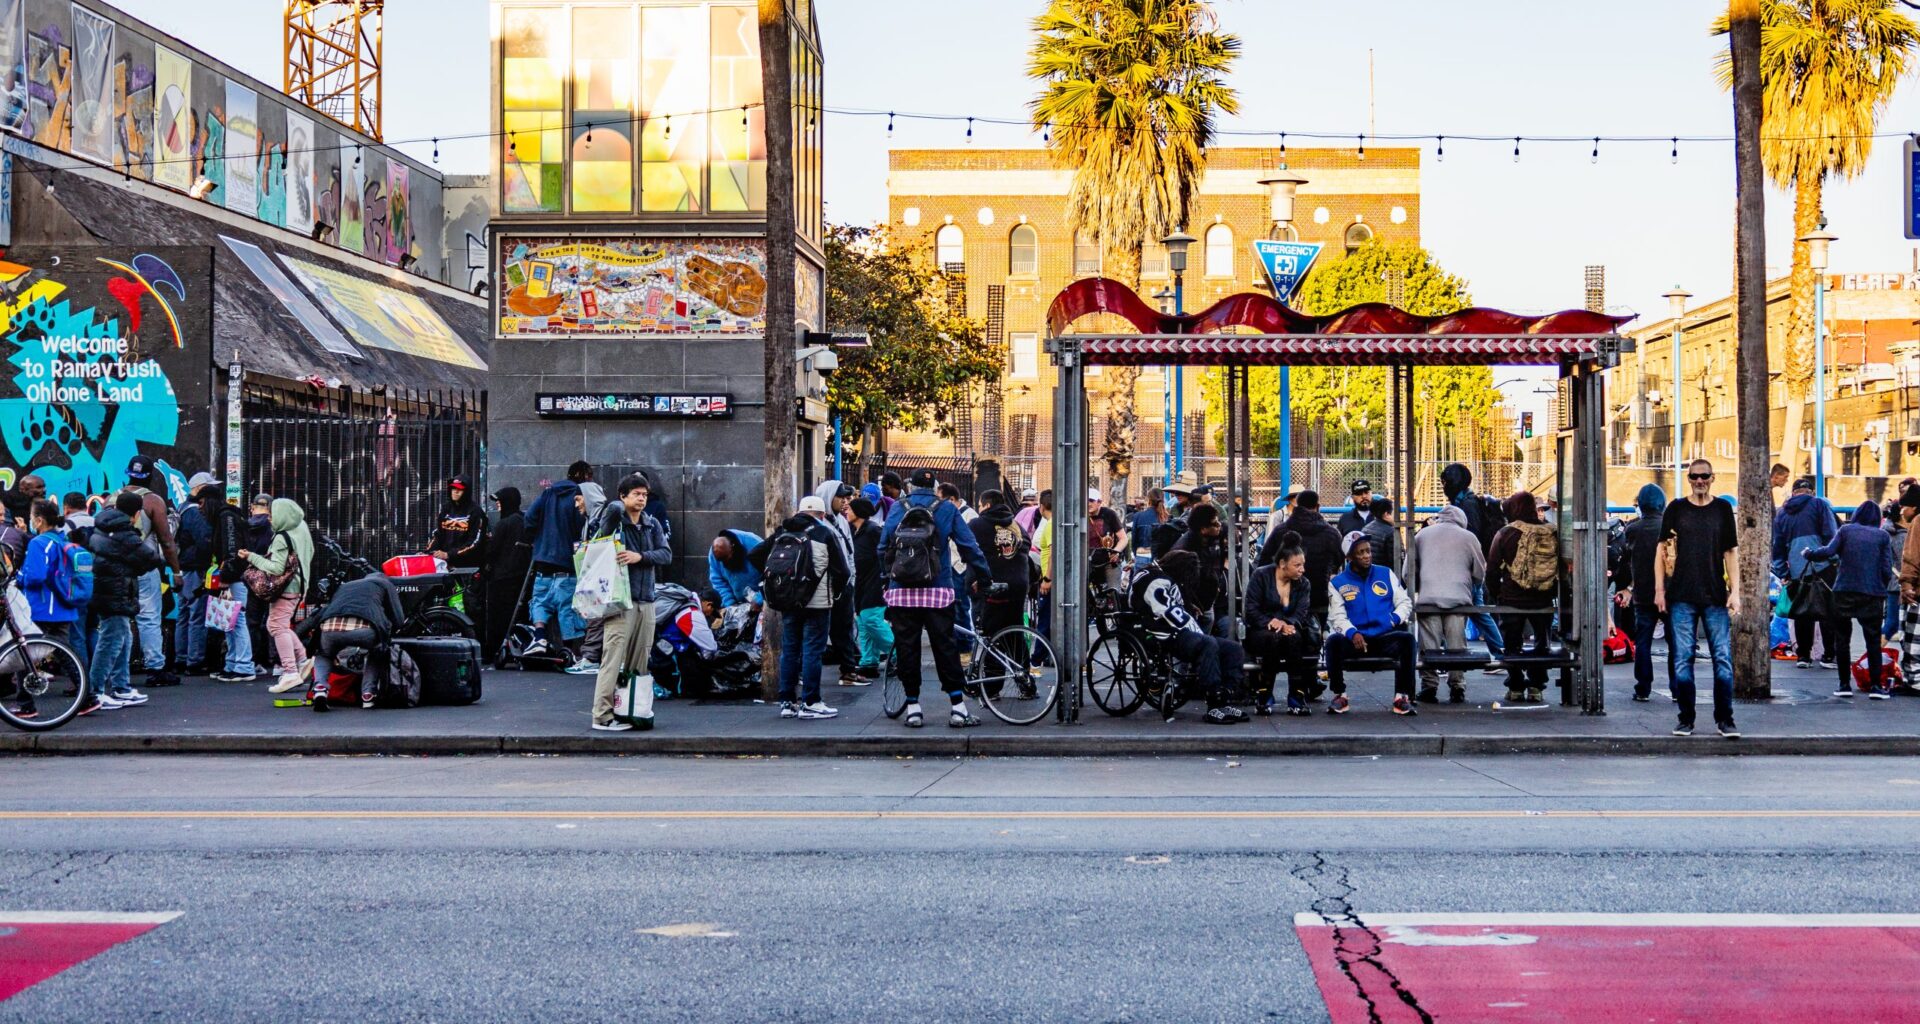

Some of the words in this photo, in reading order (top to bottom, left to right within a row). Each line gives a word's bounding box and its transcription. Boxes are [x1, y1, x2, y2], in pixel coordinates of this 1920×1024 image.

[1261, 244, 1314, 255] EMERGENCY
[1275, 275, 1295, 284] 9-1-1
[41, 334, 128, 354] Welcome
[21, 358, 44, 378] to
[51, 357, 161, 383] Ramaytush
[26, 381, 90, 403] Ohlone
[97, 382, 143, 402] Land
[618, 399, 650, 409] Trains
